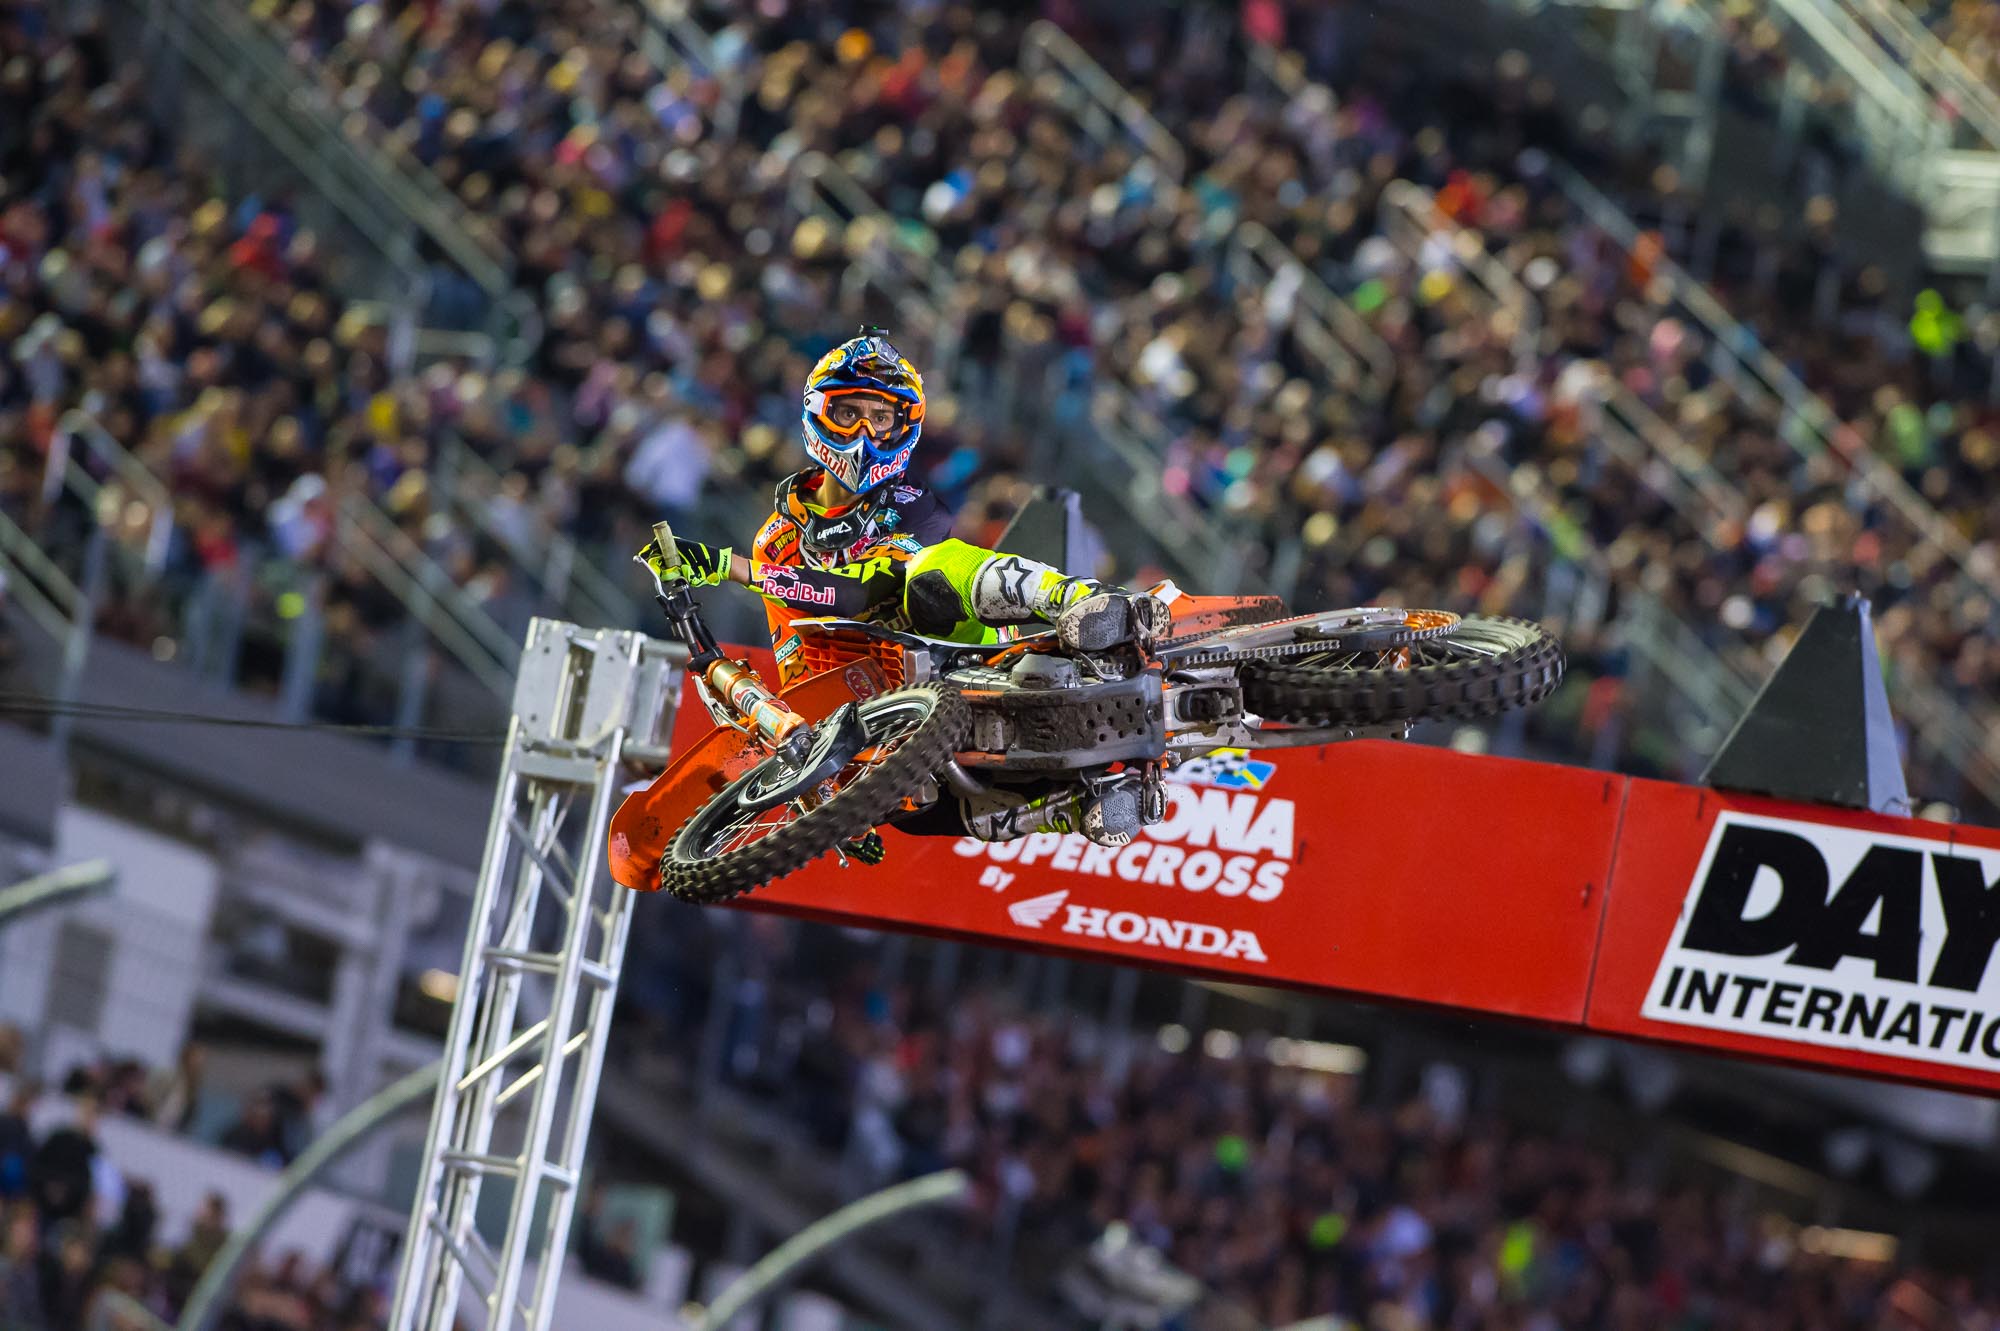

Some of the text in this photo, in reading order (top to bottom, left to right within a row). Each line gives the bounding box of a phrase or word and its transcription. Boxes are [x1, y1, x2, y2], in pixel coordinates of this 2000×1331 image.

[763, 580, 835, 606] Red Bull
[1062, 904, 1268, 963] HONDA
